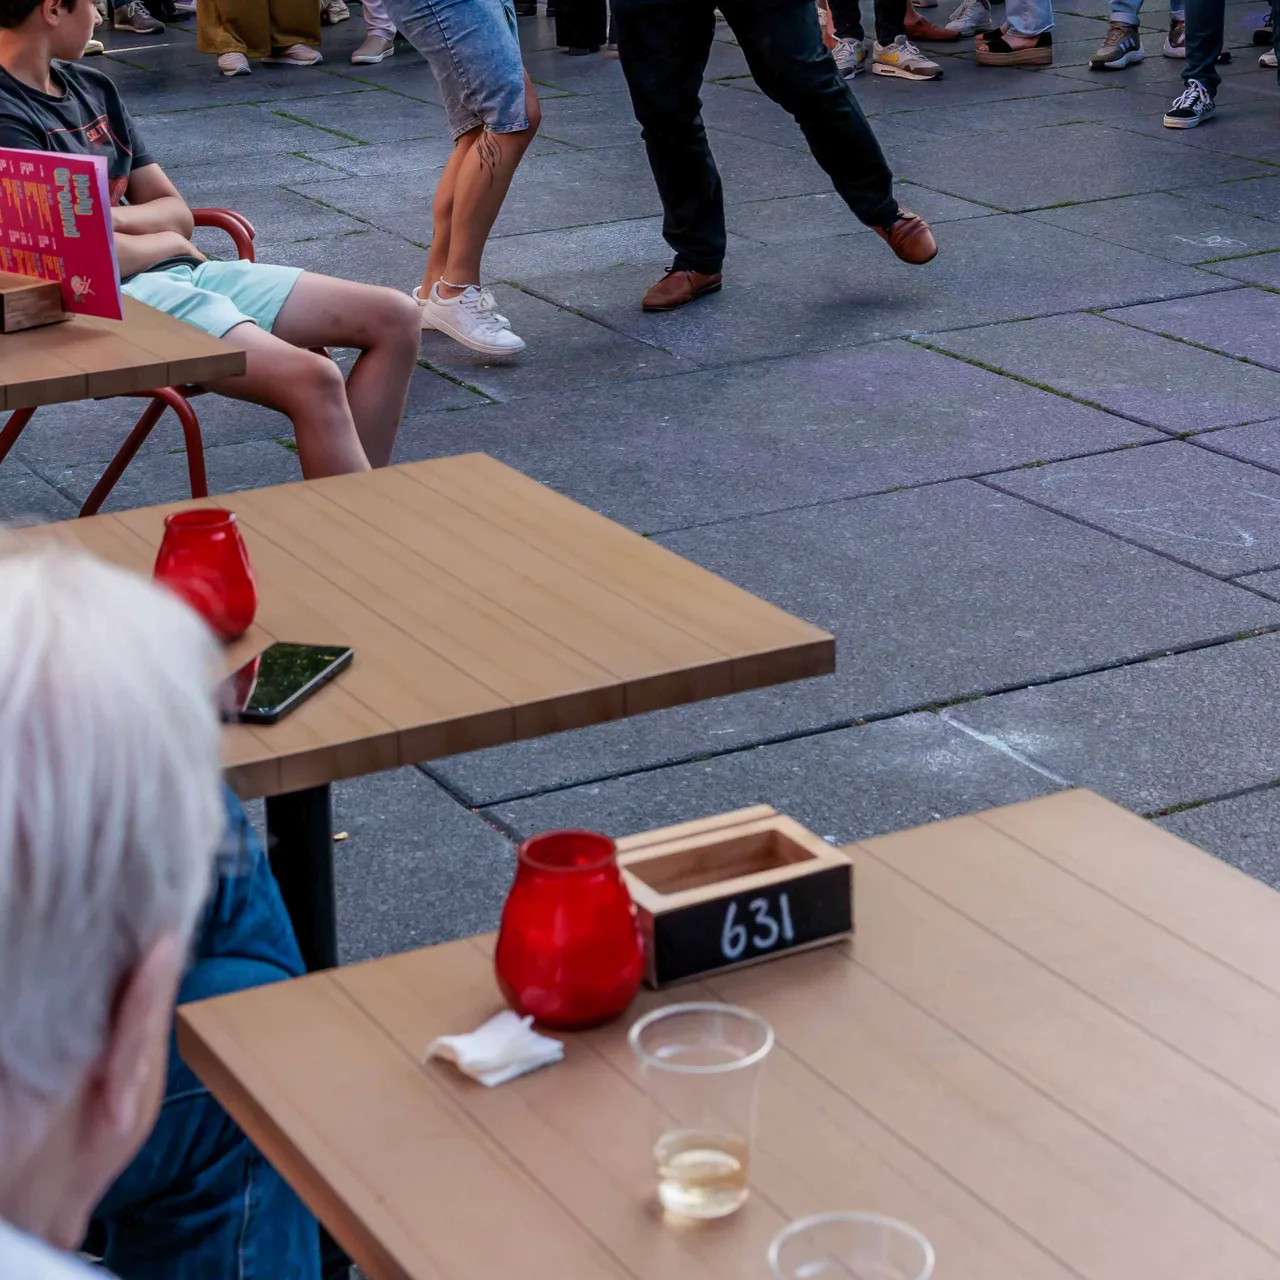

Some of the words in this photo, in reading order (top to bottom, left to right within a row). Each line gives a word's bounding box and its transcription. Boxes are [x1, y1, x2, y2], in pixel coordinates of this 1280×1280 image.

[54, 167, 81, 238] Ground
[72, 174, 94, 216] Holy
[721, 892, 795, 959] 631
